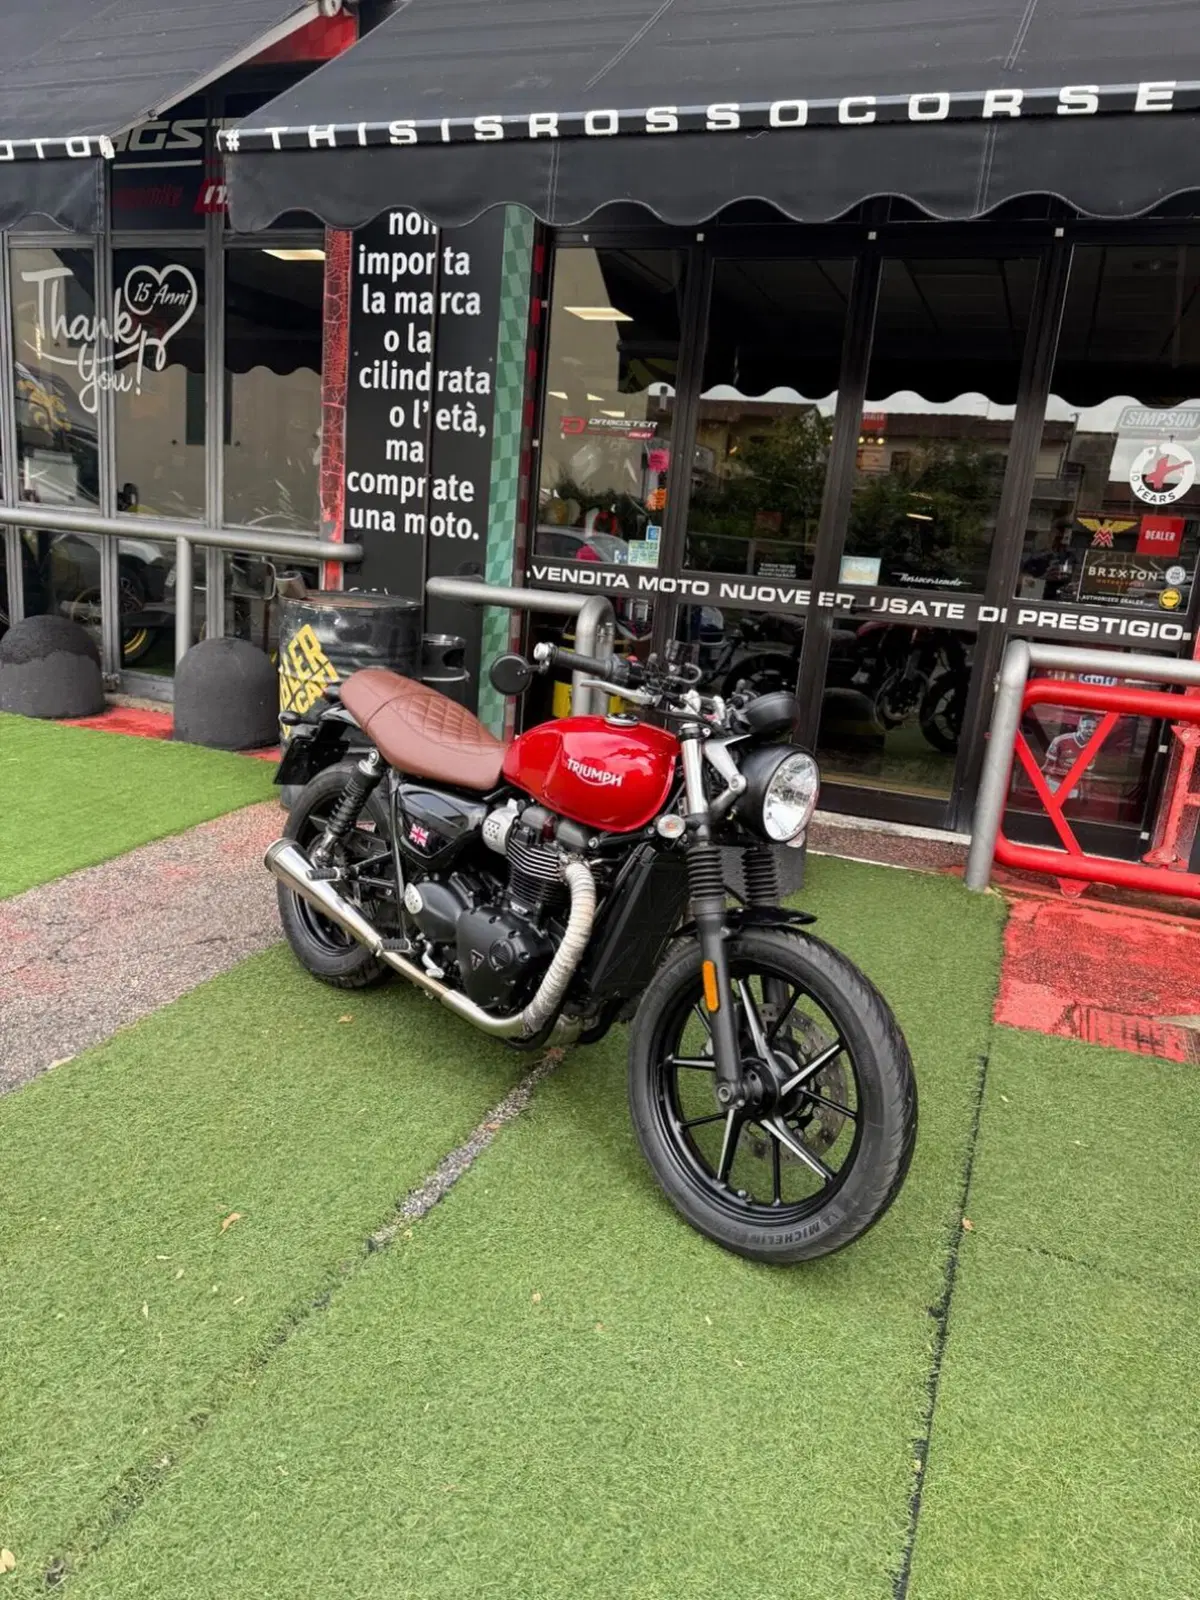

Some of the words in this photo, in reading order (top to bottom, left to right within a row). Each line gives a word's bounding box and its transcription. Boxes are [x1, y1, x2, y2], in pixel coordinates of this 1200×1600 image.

[358, 244, 470, 283] importa
[21, 267, 142, 344] Thank
[134, 282, 153, 301] 15
[154, 284, 191, 306] Anni
[363, 283, 386, 314] la
[394, 290, 481, 315] marca
[384, 330, 400, 352] o
[408, 322, 432, 353] la
[359, 360, 491, 394] cilindrata
[389, 406, 405, 428] o
[1126, 411, 1198, 428] SIMPSON
[385, 439, 424, 463] ma
[347, 471, 475, 504] comprate
[1136, 485, 1177, 503] YEARS
[349, 507, 396, 532] una
[404, 513, 480, 541] moto.
[1144, 530, 1176, 542] DEALER
[1088, 566, 1158, 581] BRIXTON
[638, 575, 709, 597] MOTO
[719, 582, 812, 606] NUOVE
[977, 606, 1008, 624] DI
[567, 758, 623, 787] TRIUMPH
[751, 1221, 821, 1246] MICHELIN
